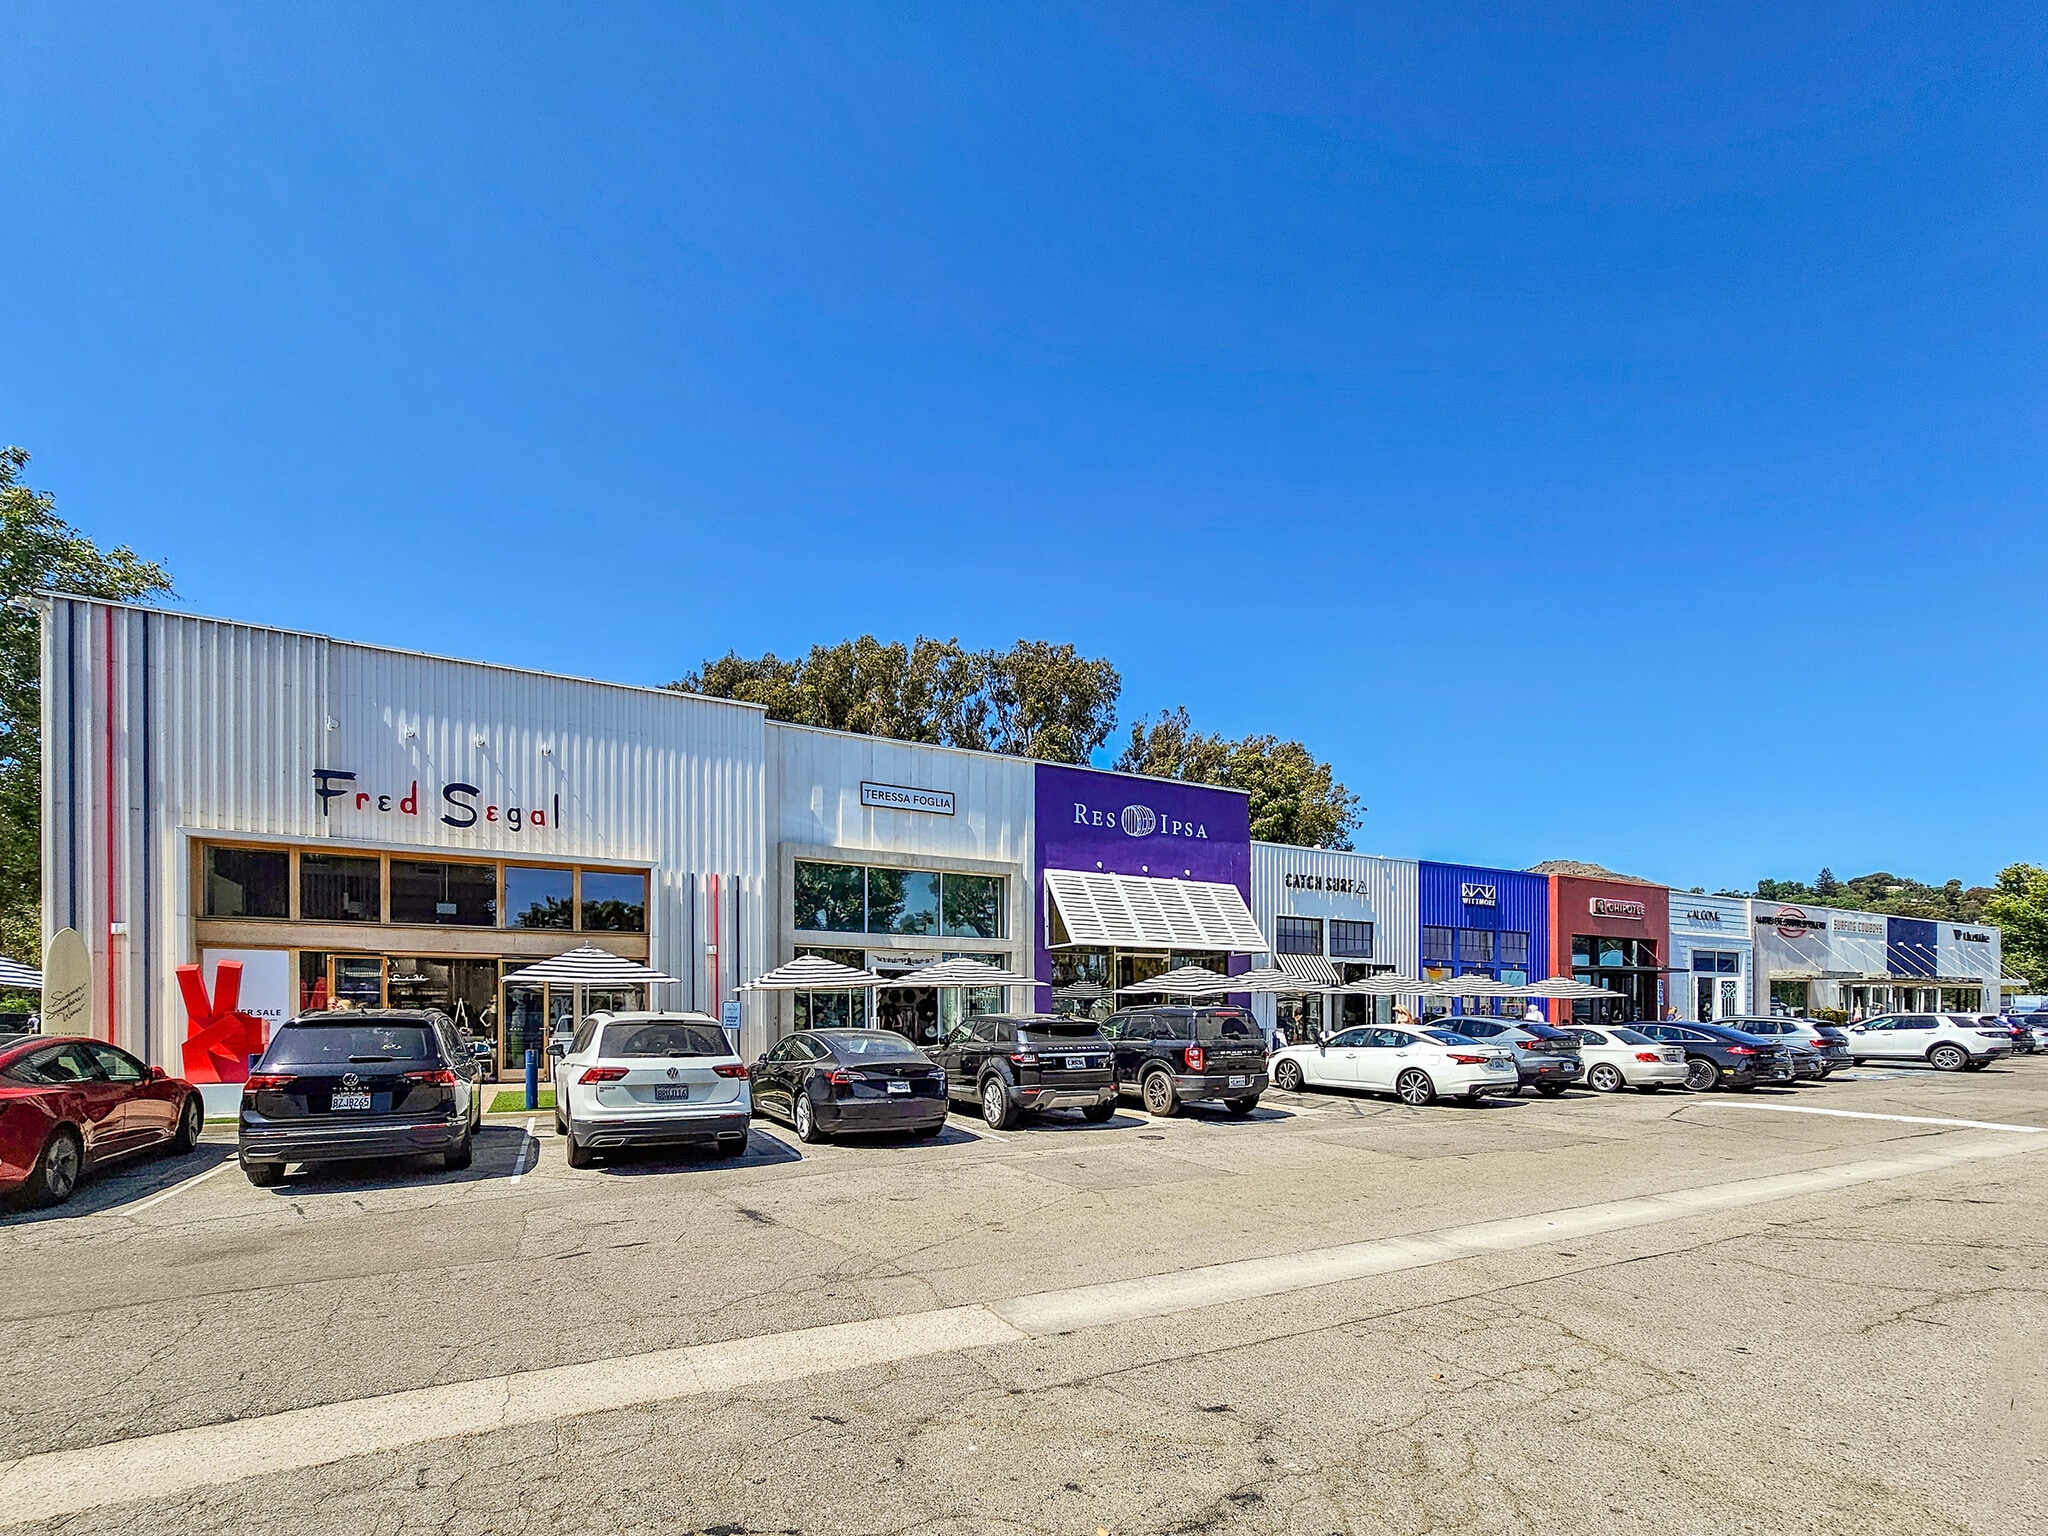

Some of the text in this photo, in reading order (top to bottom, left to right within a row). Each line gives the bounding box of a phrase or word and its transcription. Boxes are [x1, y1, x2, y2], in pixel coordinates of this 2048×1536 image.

[311, 768, 559, 832] Fred Segal
[864, 788, 951, 809] TERESSA FOGLIA
[1285, 873, 1354, 893] CATCH SURF
[1607, 903, 1645, 915] CHIPOTLE
[1833, 919, 1857, 932] SURFING
[1858, 922, 1883, 934] COWBOYS
